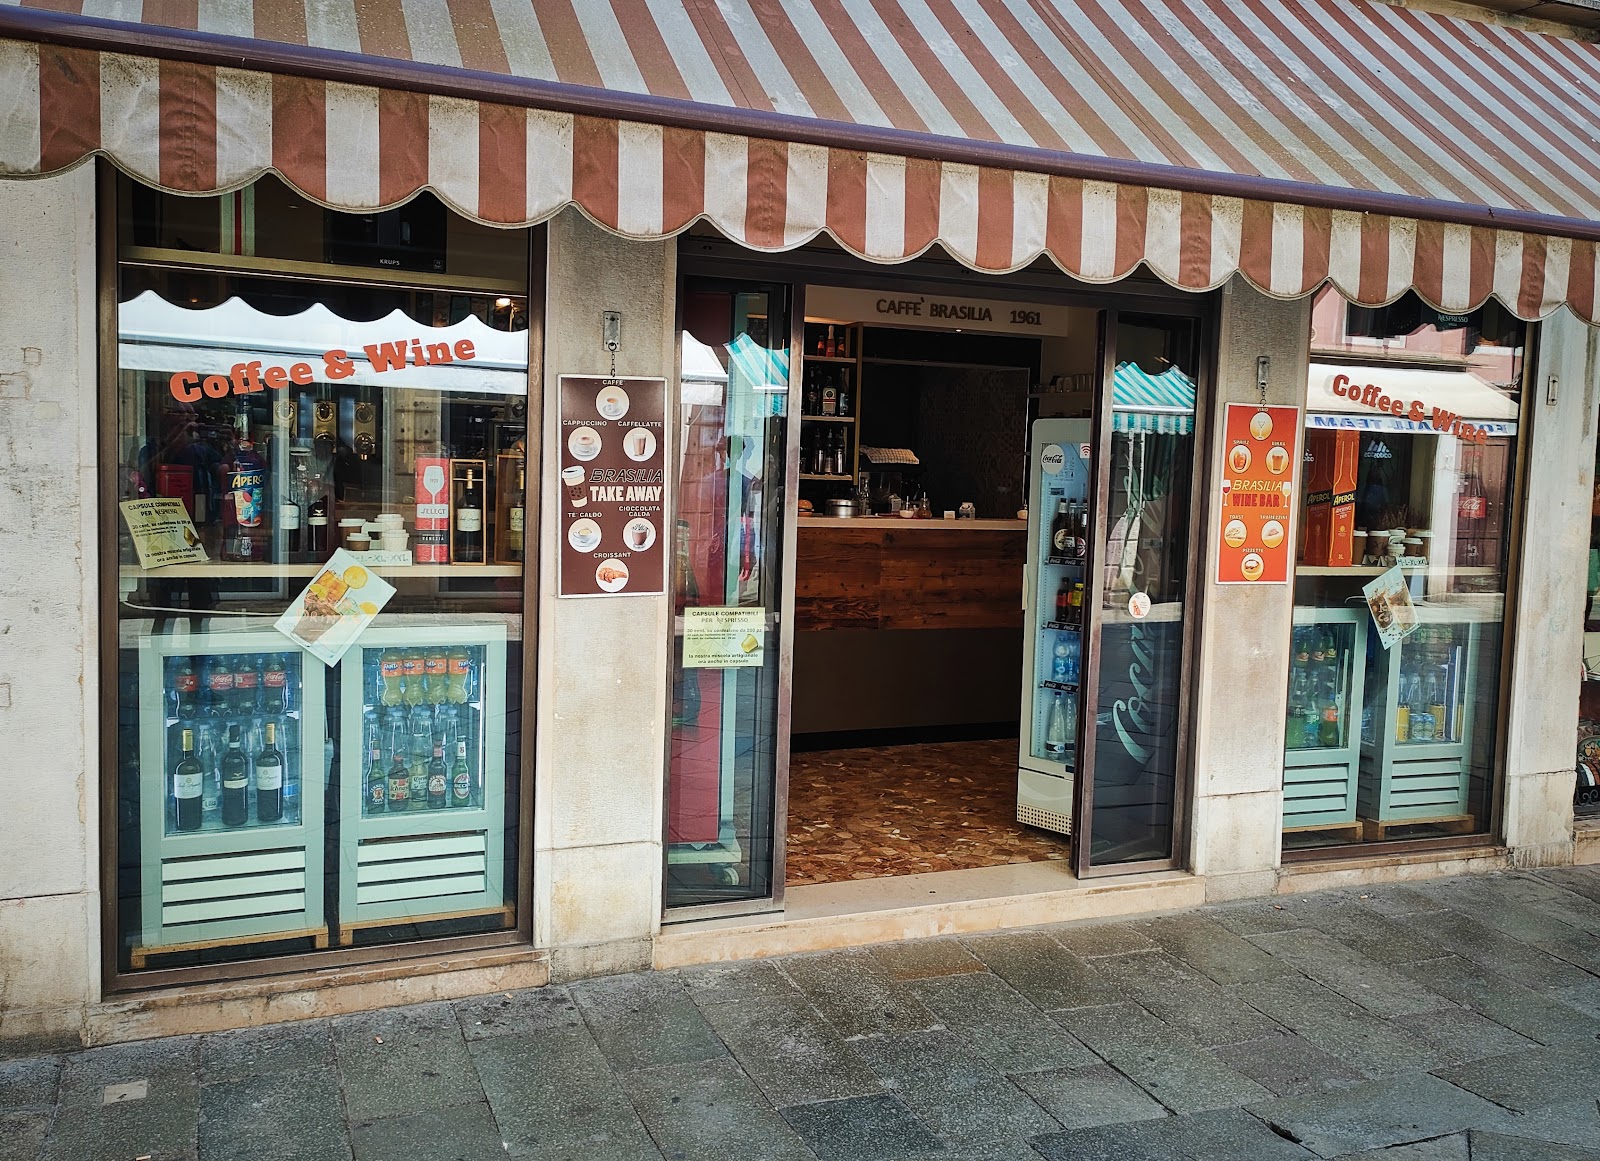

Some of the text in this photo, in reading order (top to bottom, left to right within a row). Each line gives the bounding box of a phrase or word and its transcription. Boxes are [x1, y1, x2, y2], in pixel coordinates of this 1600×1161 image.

[929, 303, 993, 322] BRASILIA
[1010, 310, 1042, 325] 1961
[1437, 313, 1469, 323] NESPRESSO
[169, 338, 476, 404] Coffee & Wine
[1332, 374, 1488, 445] Coffee & Wine
[232, 474, 264, 488] APERO
[589, 468, 663, 483] BRASILIA
[1232, 479, 1283, 492] BRASILIA
[589, 485, 663, 502] TAKE AWAY
[1232, 493, 1280, 507] WINE BAR
[1308, 493, 1331, 504] APEROL
[1333, 493, 1355, 506] APEROL
[128, 502, 155, 510] CAPSULE
